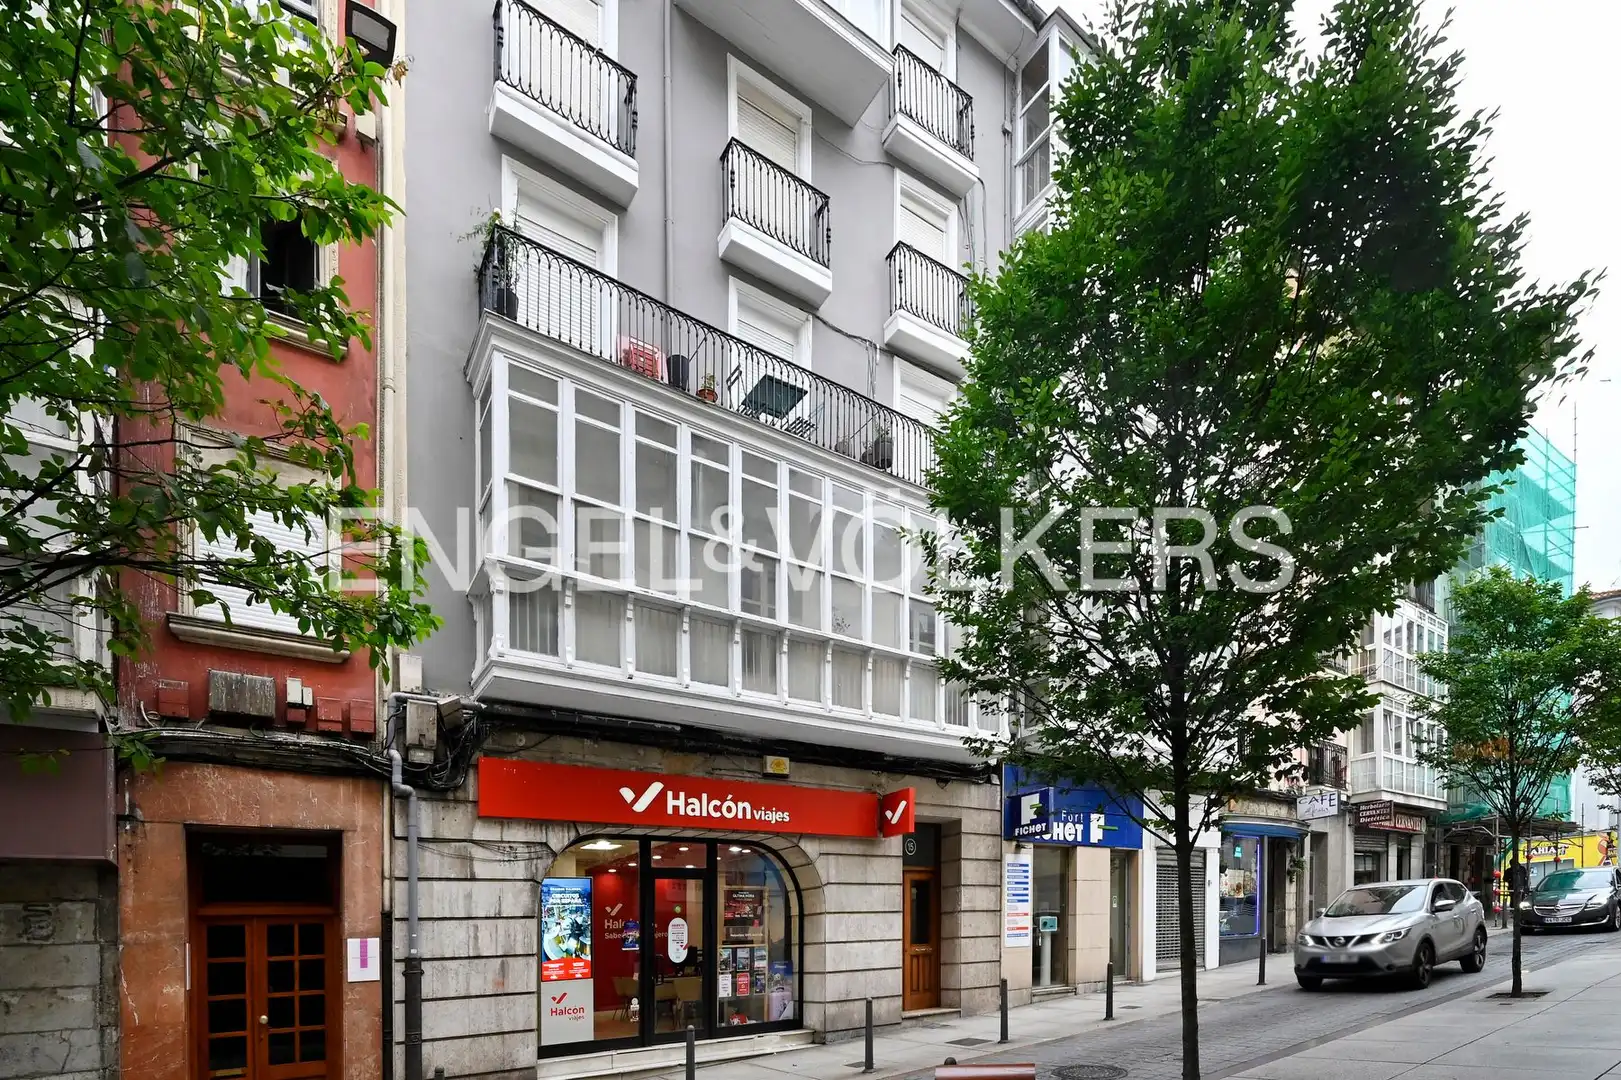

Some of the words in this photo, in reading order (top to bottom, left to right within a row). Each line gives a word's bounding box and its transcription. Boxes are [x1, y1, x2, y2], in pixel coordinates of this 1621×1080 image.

[667, 790, 752, 819] Halcón
[753, 806, 790, 824] viajes
[1062, 810, 1083, 823] Fort
